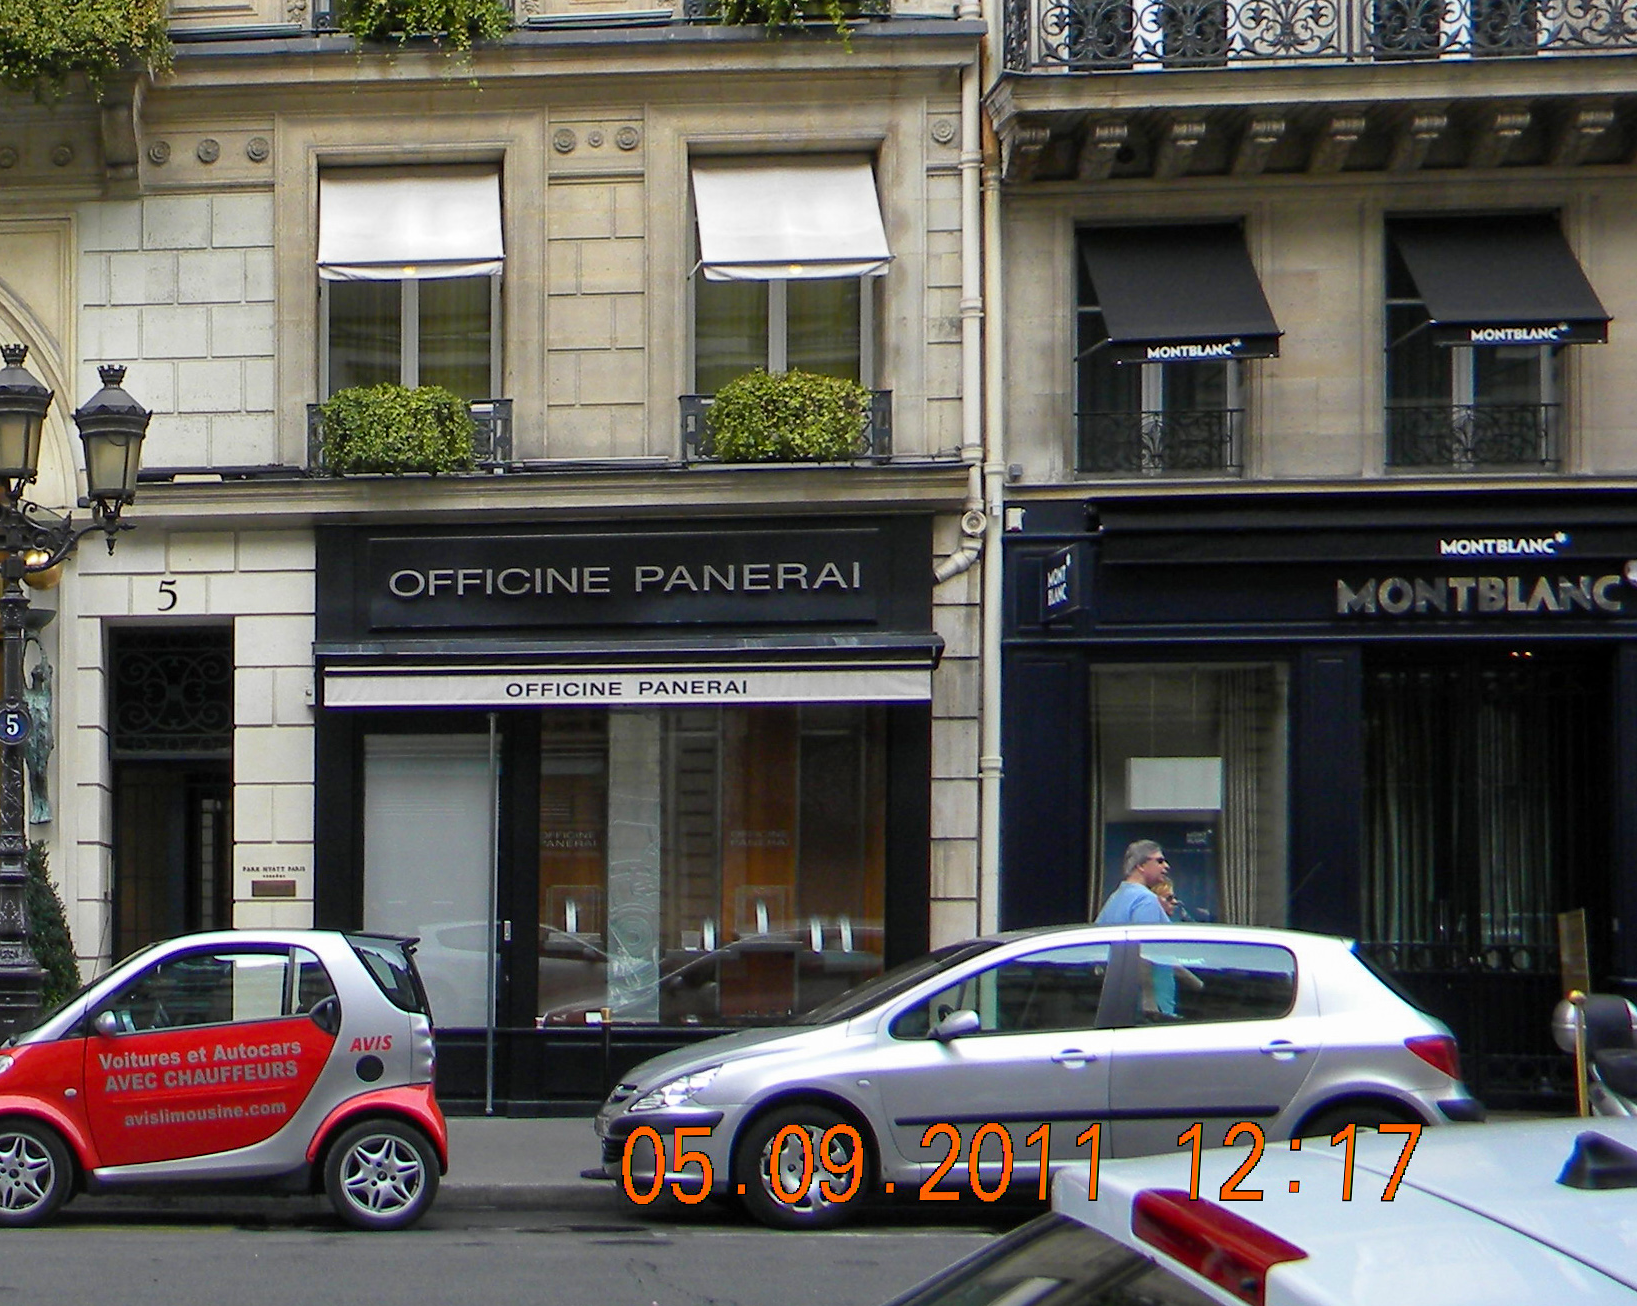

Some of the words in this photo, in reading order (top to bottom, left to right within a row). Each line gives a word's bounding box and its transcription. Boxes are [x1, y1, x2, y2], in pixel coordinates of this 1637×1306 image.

[1471, 326, 1558, 342] MONTBLANC
[1147, 343, 1232, 359] MONTBLANC
[1440, 538, 1556, 555] MONTBLANC
[389, 565, 611, 597] OFFICINE
[635, 561, 861, 593] PANERAI
[157, 579, 178, 611] 5
[1336, 574, 1622, 614] MONTBLANC
[505, 681, 623, 698] OFFICINE
[638, 680, 748, 696] PANERAI
[6, 712, 20, 736] 5
[98, 1049, 181, 1070] Voitures
[187, 1048, 206, 1063] et
[212, 1040, 301, 1061] Autocars
[349, 1035, 393, 1053] AVIS
[105, 1071, 157, 1092] AVEC
[163, 1060, 298, 1087] CHAUFFEURS
[124, 1099, 287, 1127] avislimousine.com
